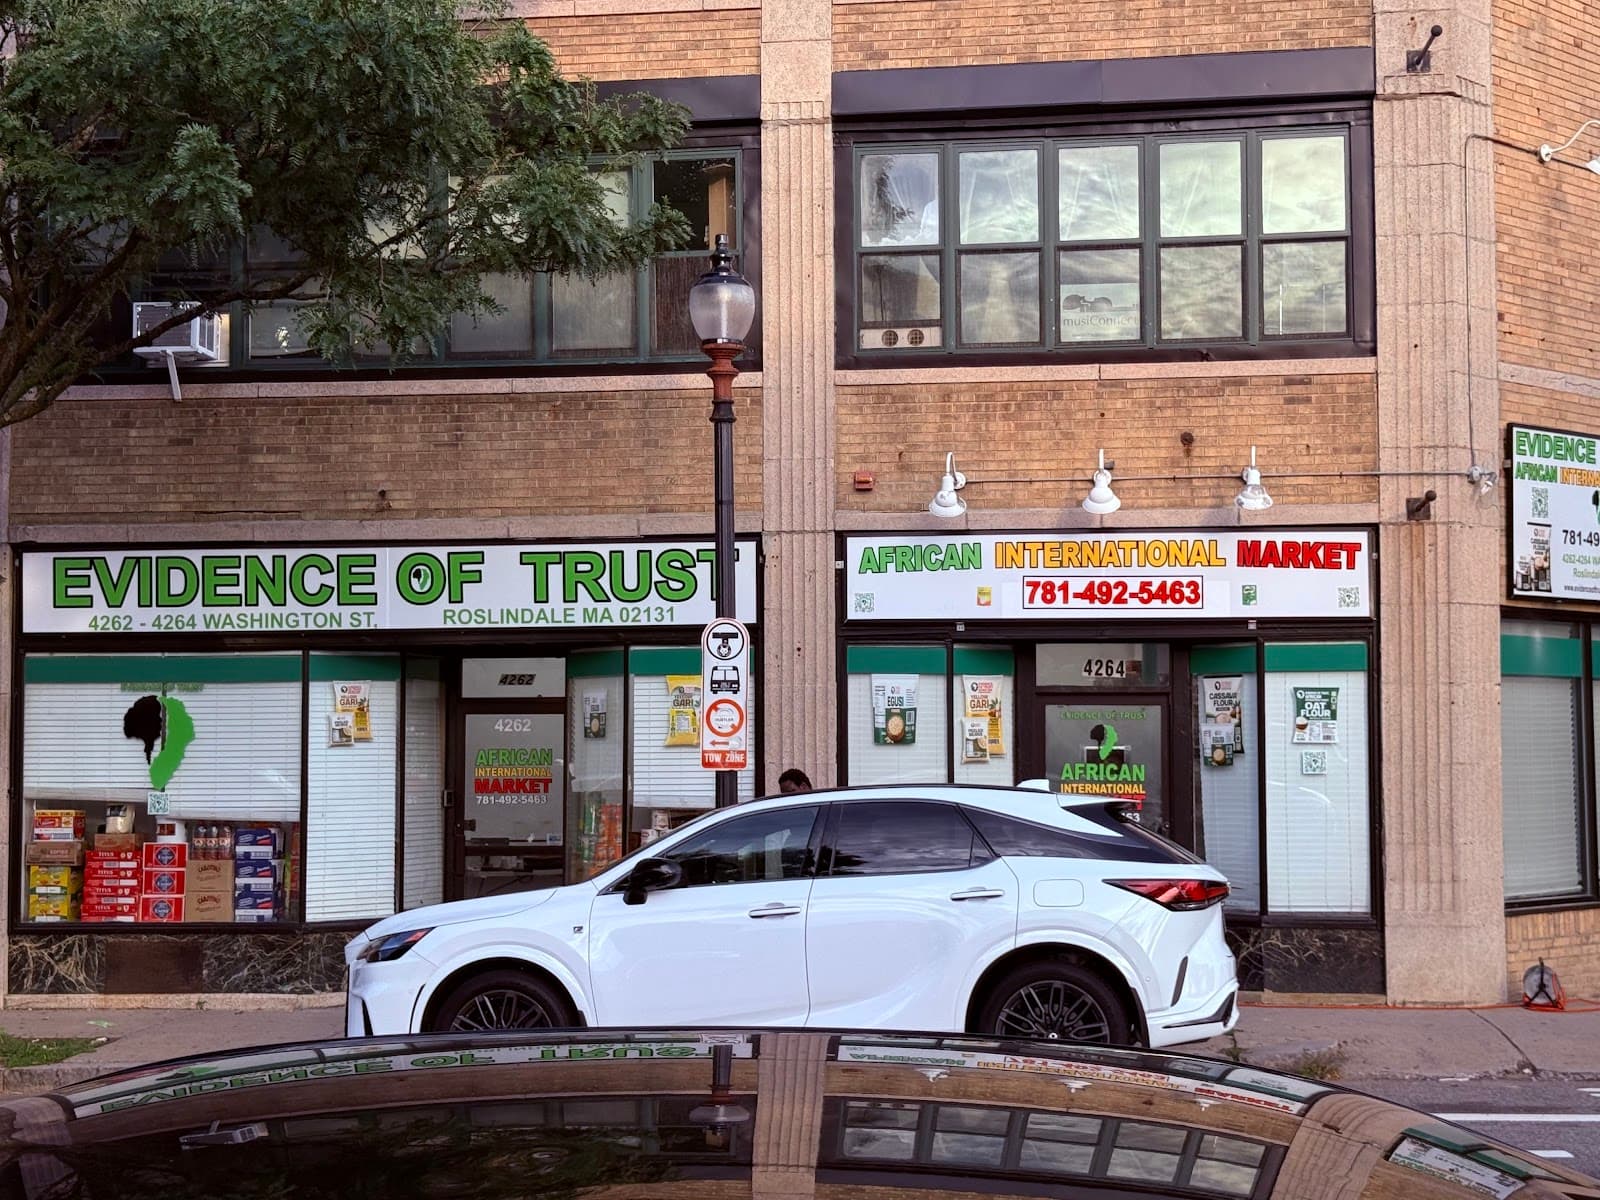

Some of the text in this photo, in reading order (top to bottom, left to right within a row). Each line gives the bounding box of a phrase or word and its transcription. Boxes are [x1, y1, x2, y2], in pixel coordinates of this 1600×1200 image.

[1515, 430, 1596, 464] EVIDENCE
[1515, 461, 1558, 483] AFRICAN
[1562, 529, 1600, 547] 781-49
[858, 539, 1362, 574] AFRICAN INTERNATIONAL MARKET
[53, 553, 378, 609] EVIDENCE
[396, 551, 485, 606] OF
[1025, 580, 1201, 605] 781-492-5463
[88, 614, 133, 632] 4262
[152, 613, 197, 630] 4264
[203, 612, 343, 630] WASHINGTON
[349, 611, 378, 629] ST.
[443, 606, 675, 625] ROSLINDALE MA 02131
[1083, 659, 1125, 677] 4264
[498, 673, 536, 686] 4262
[340, 698, 358, 706] GARI
[887, 696, 904, 707] EGUSI
[1209, 692, 1238, 700] CASSAVA
[673, 699, 694, 707] GARI
[970, 699, 989, 709] GARI
[1213, 699, 1234, 707] FLOUR
[1304, 701, 1327, 709] OAT
[1060, 711, 1147, 720] EVIDENCE OF TRUST
[1300, 709, 1331, 718] FLOUR
[494, 719, 532, 732] 4262
[475, 748, 553, 766] AFRICAN
[704, 752, 745, 763] TOW ZONE
[475, 767, 552, 777] INTERNATIONAL
[1061, 763, 1145, 782] AFRICAN
[474, 778, 553, 794] MARKET
[1060, 783, 1146, 794] INTERNATIONAL
[476, 795, 547, 805] 781-492-5463
